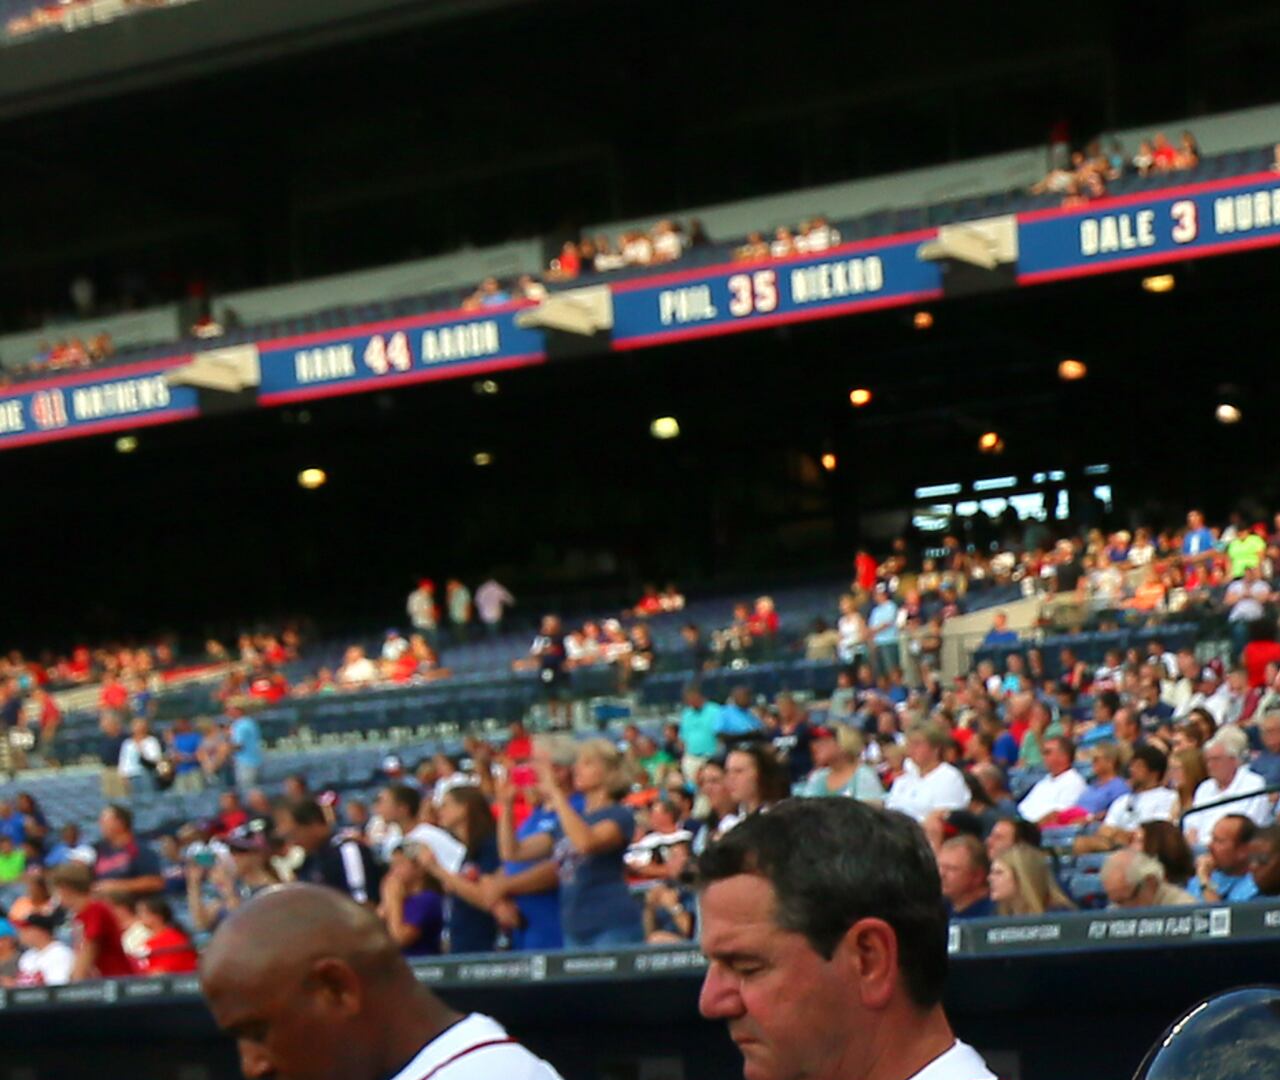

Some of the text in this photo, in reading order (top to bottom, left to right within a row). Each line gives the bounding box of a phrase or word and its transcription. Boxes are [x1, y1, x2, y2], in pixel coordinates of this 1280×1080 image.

[1080, 209, 1156, 257] DALE
[1170, 199, 1197, 243] 3
[659, 283, 718, 326] PHIL
[727, 268, 777, 318] 35
[363, 329, 412, 376] 44
